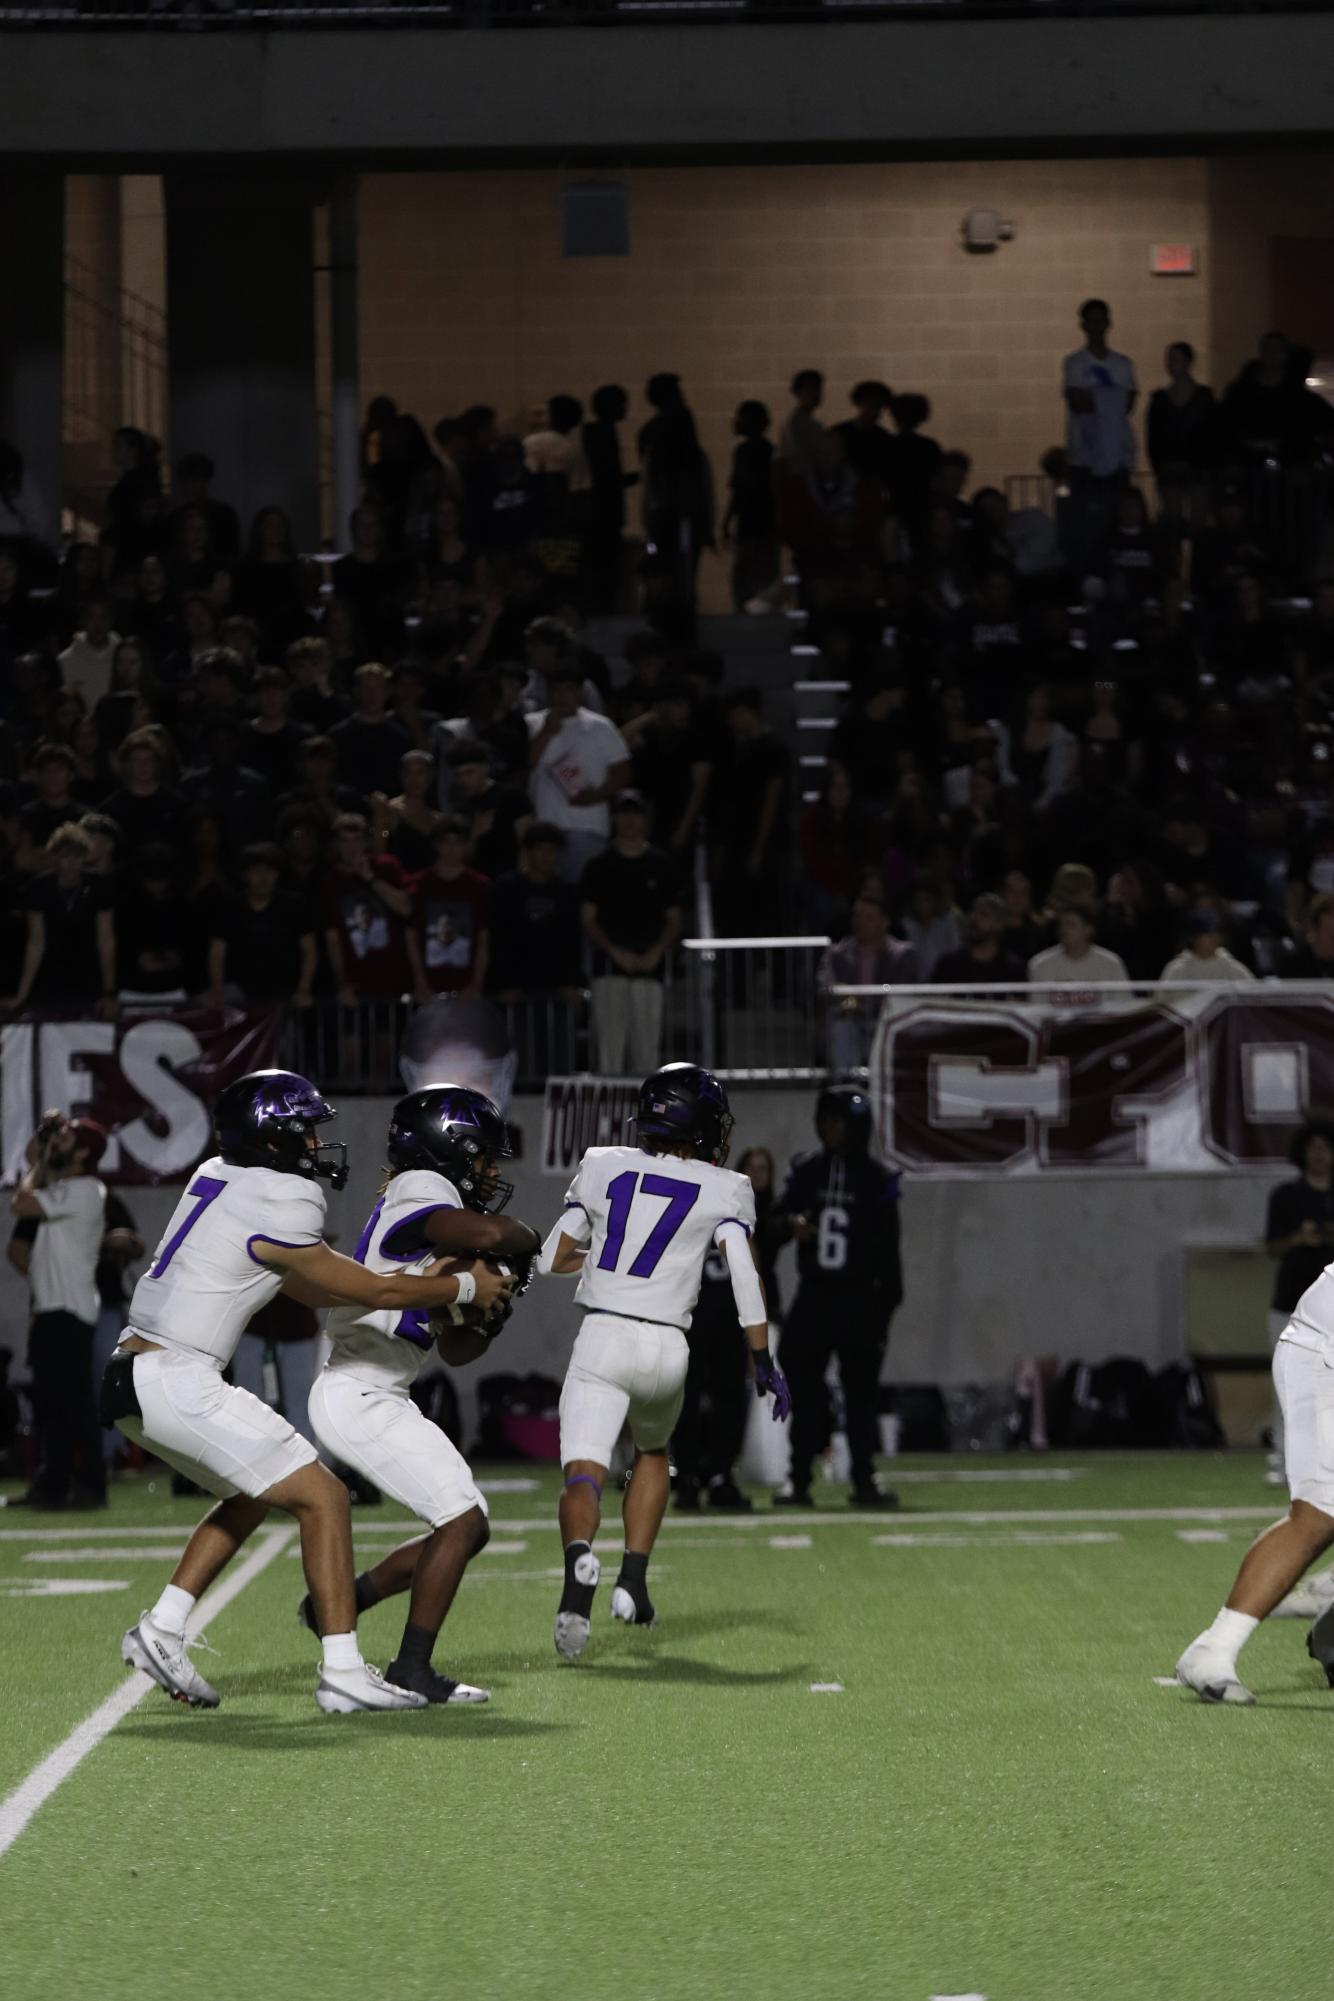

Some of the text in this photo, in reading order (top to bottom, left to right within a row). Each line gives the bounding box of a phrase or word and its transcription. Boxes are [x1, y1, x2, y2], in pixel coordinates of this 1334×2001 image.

[150, 1176, 227, 1279] 7
[597, 1171, 701, 1278] 17
[817, 1207, 850, 1270] 6
